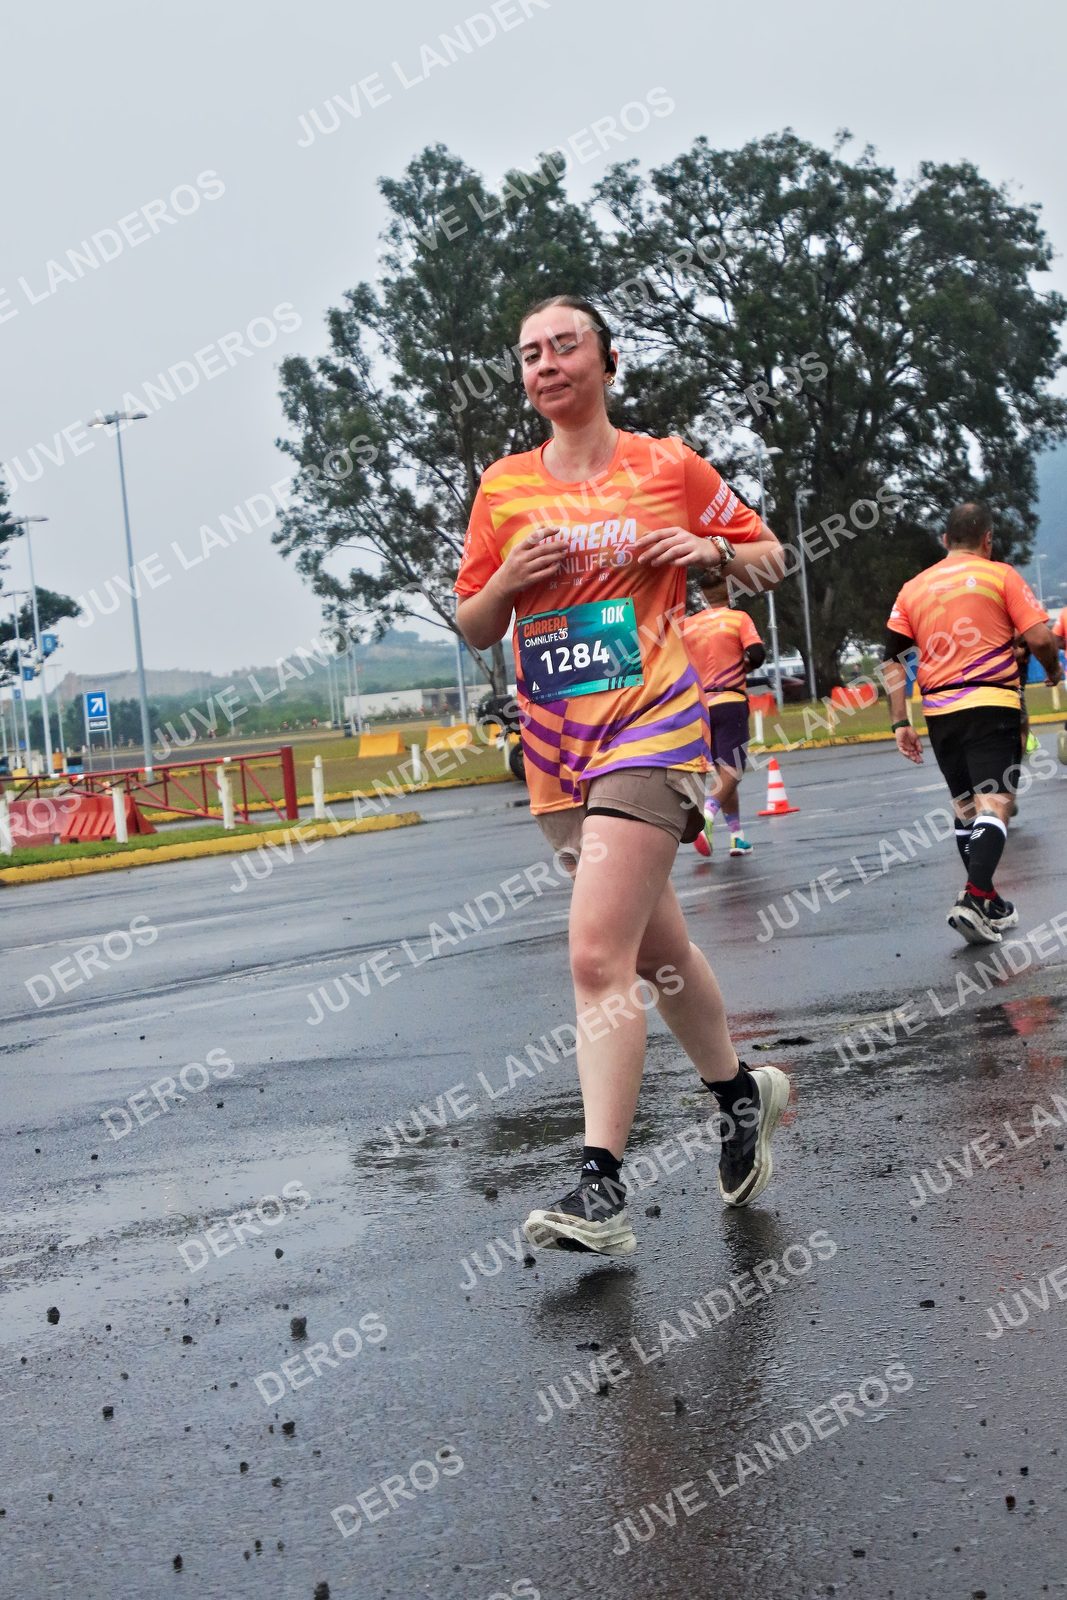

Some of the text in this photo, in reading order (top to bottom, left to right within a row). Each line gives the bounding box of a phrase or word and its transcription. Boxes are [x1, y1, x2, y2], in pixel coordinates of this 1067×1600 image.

[539, 518, 637, 552] RRERA
[557, 551, 609, 576] NILIFE
[523, 616, 568, 637] CARRERA
[601, 606, 625, 625] 10K
[540, 640, 610, 675] 1284
